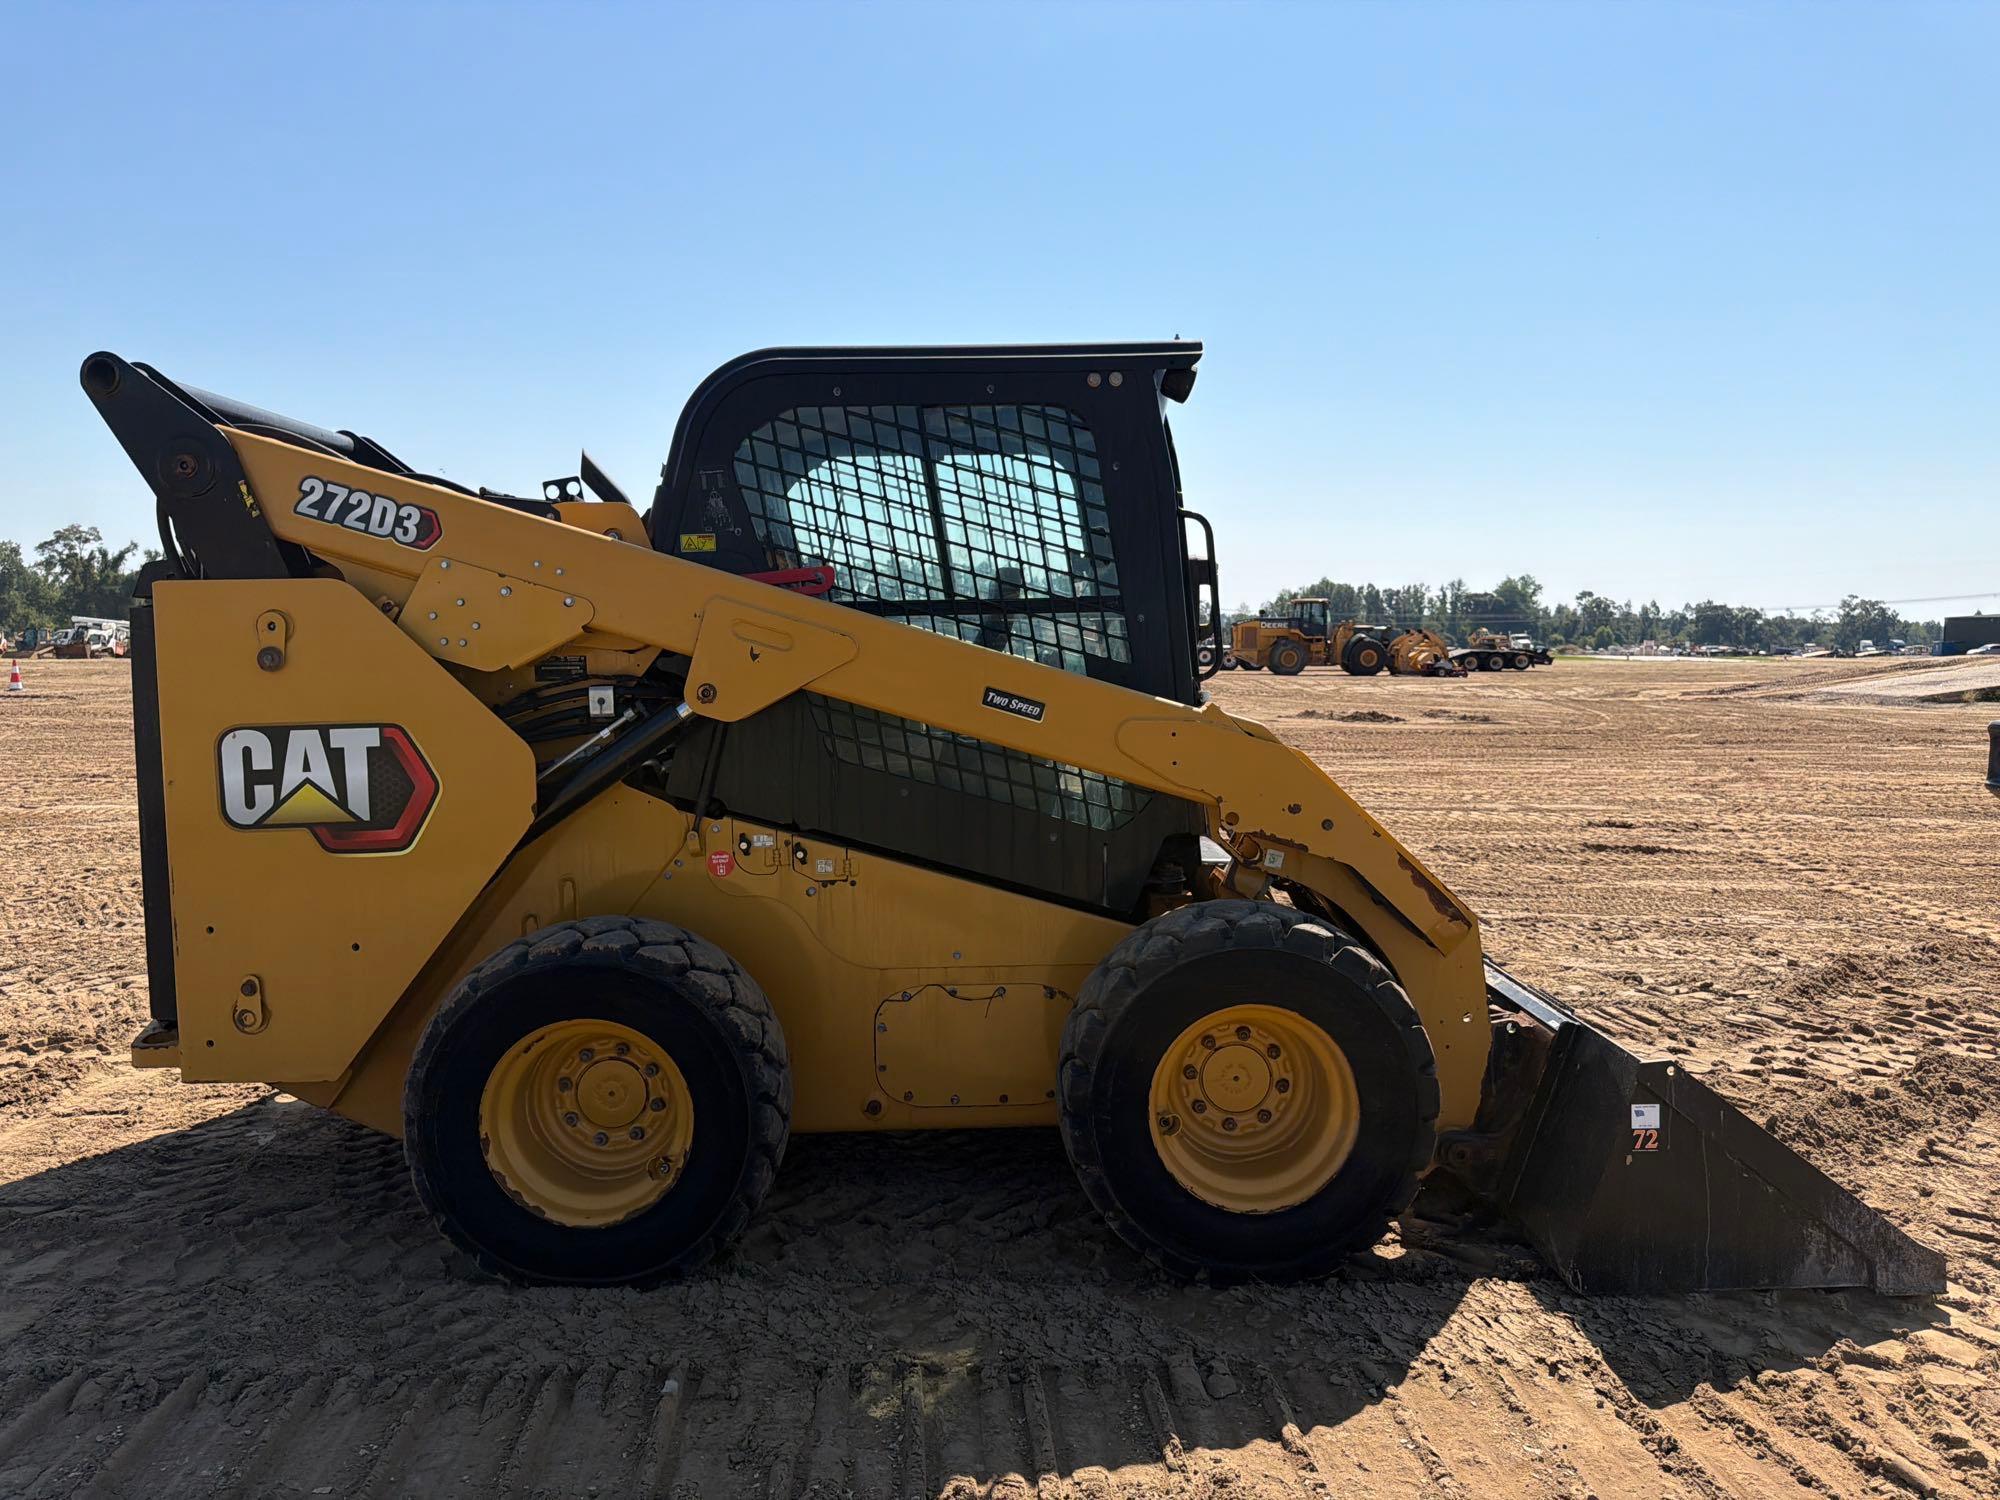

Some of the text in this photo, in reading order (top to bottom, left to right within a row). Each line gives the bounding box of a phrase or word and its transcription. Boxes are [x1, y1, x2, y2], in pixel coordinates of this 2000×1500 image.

[296, 478, 421, 543] 272D3
[1260, 621, 1289, 629] DEERE
[221, 727, 381, 825] CAT
[1632, 1129, 1659, 1149] 72
